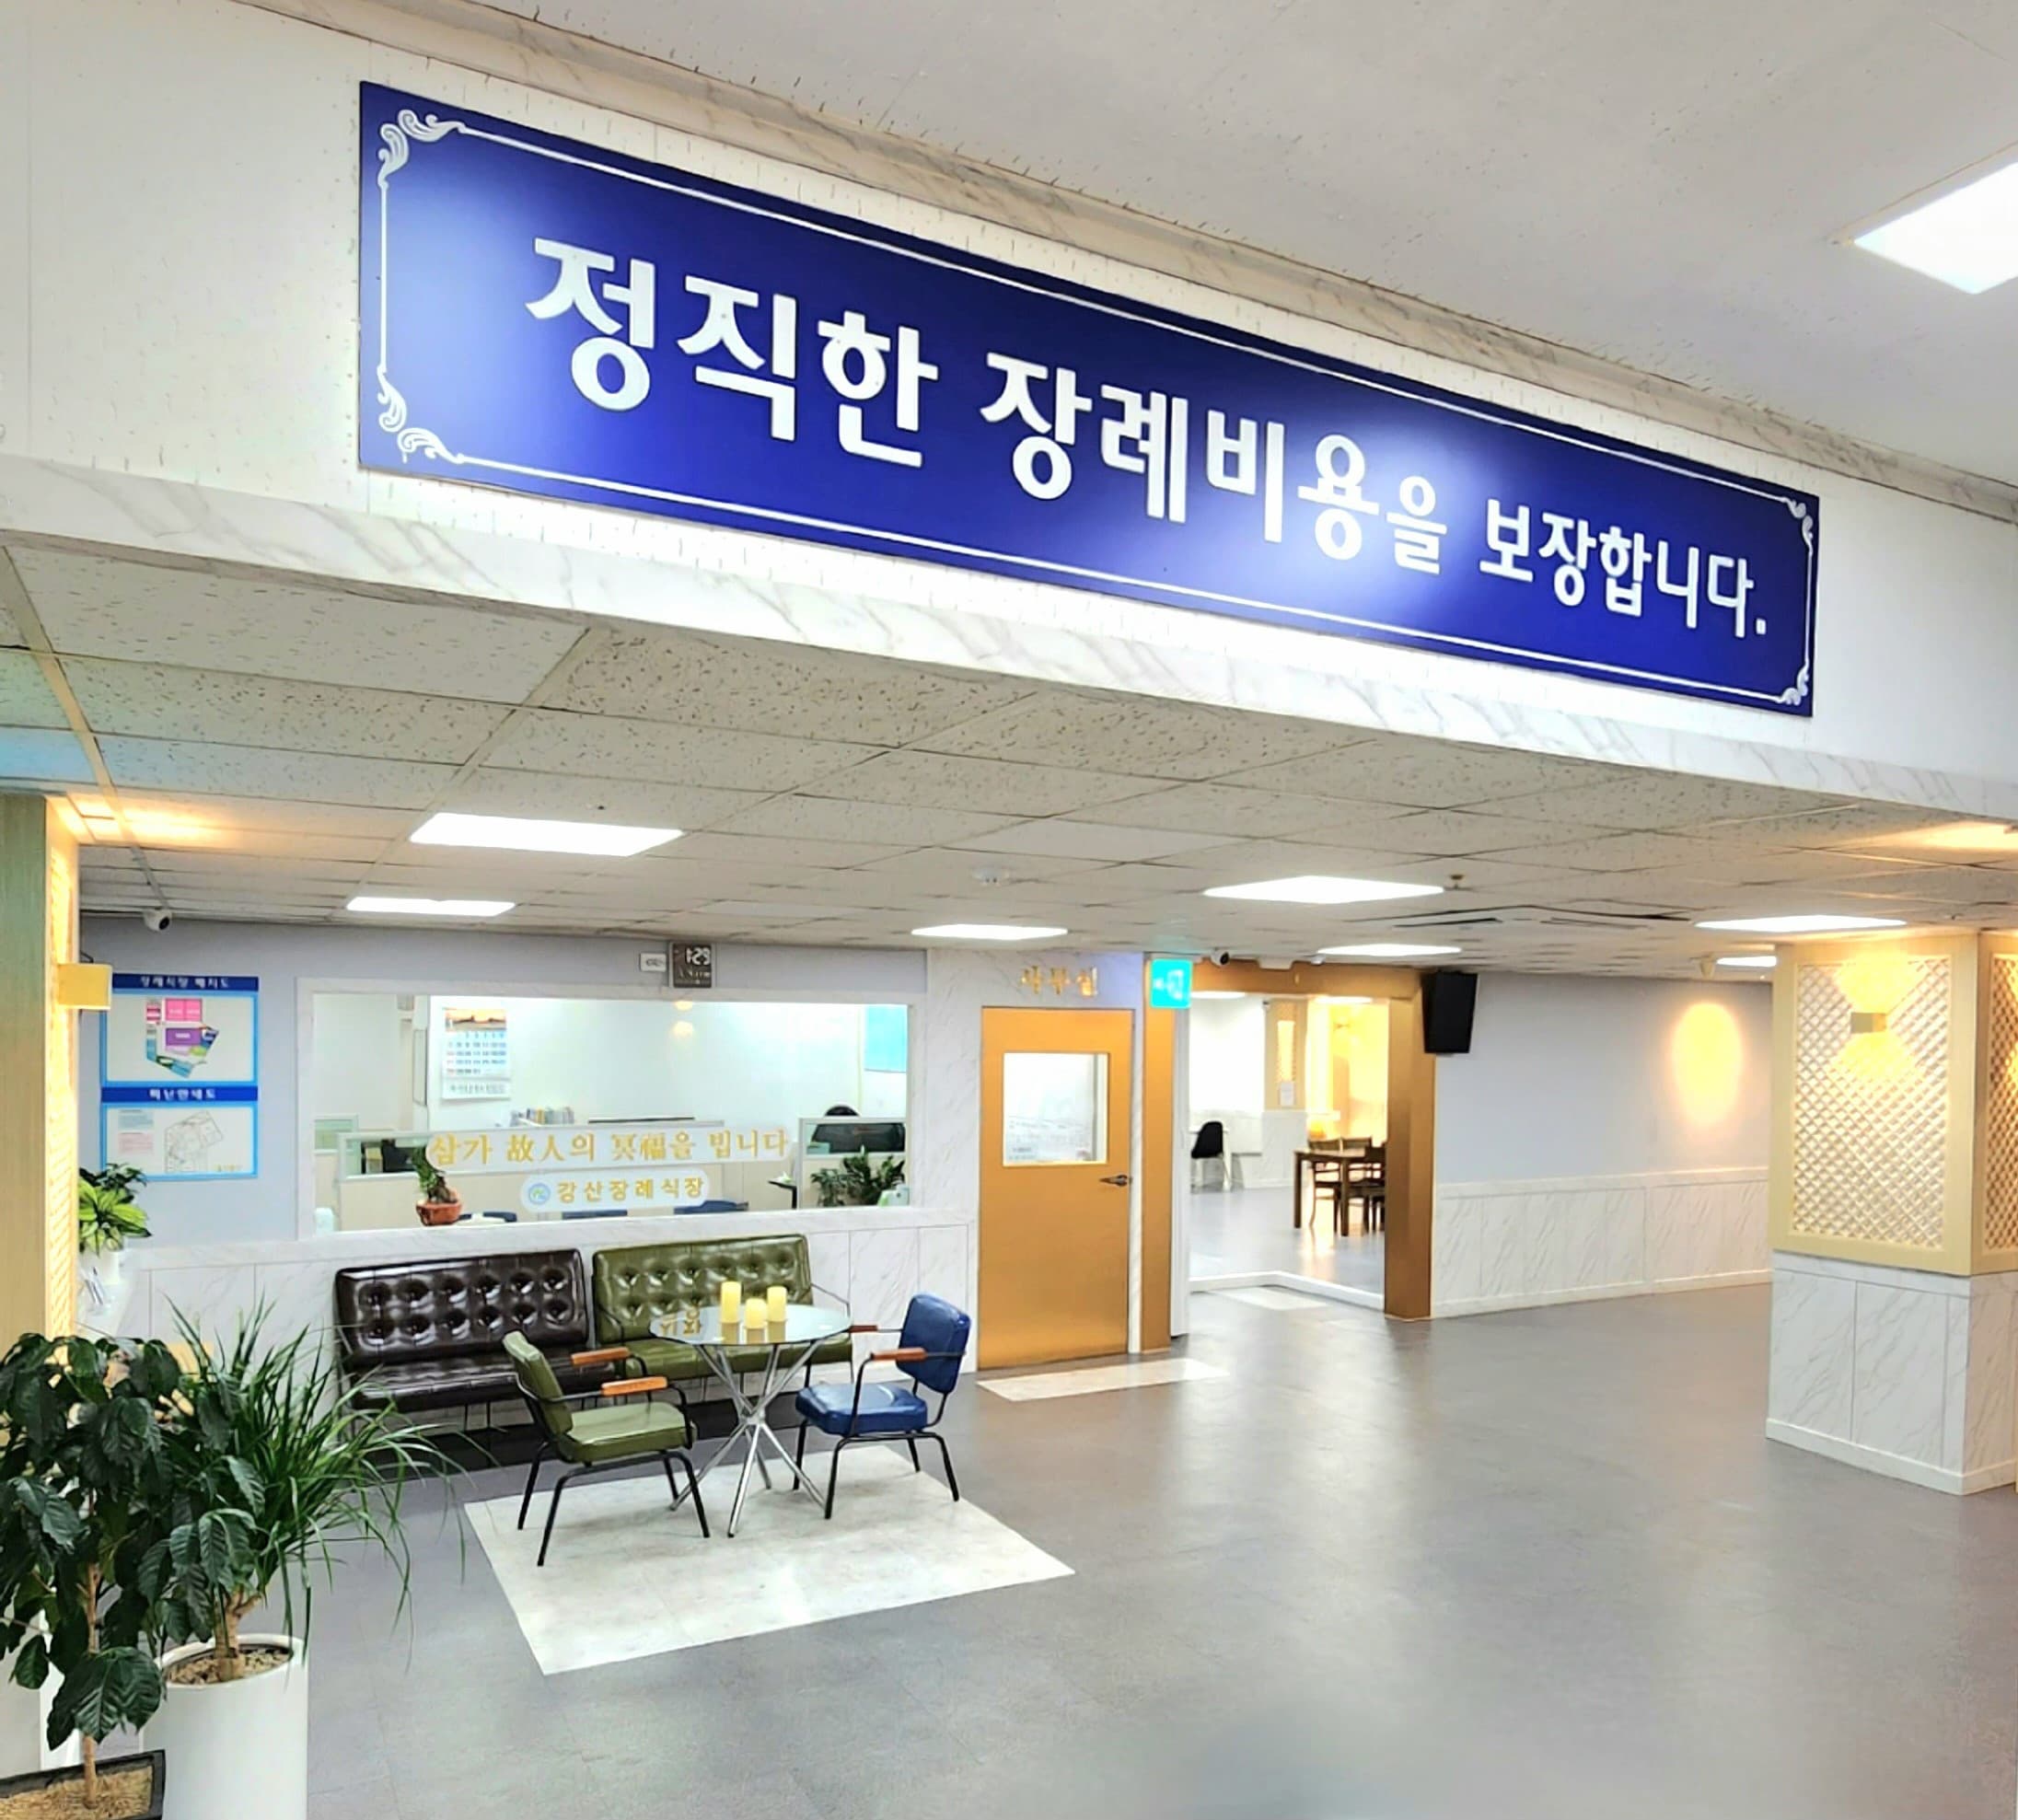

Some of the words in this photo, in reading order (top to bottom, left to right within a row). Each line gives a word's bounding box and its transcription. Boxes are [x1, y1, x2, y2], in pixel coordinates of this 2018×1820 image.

[525, 238, 938, 468] 정직한
[980, 353, 1447, 574] 장례비용을
[1479, 498, 1767, 638] 보장합니다.
[433, 1132, 493, 1166] 삼가
[506, 1132, 596, 1164] 故人의
[708, 1128, 788, 1159] 빕니다
[556, 1175, 704, 1203] 강산장례식장
